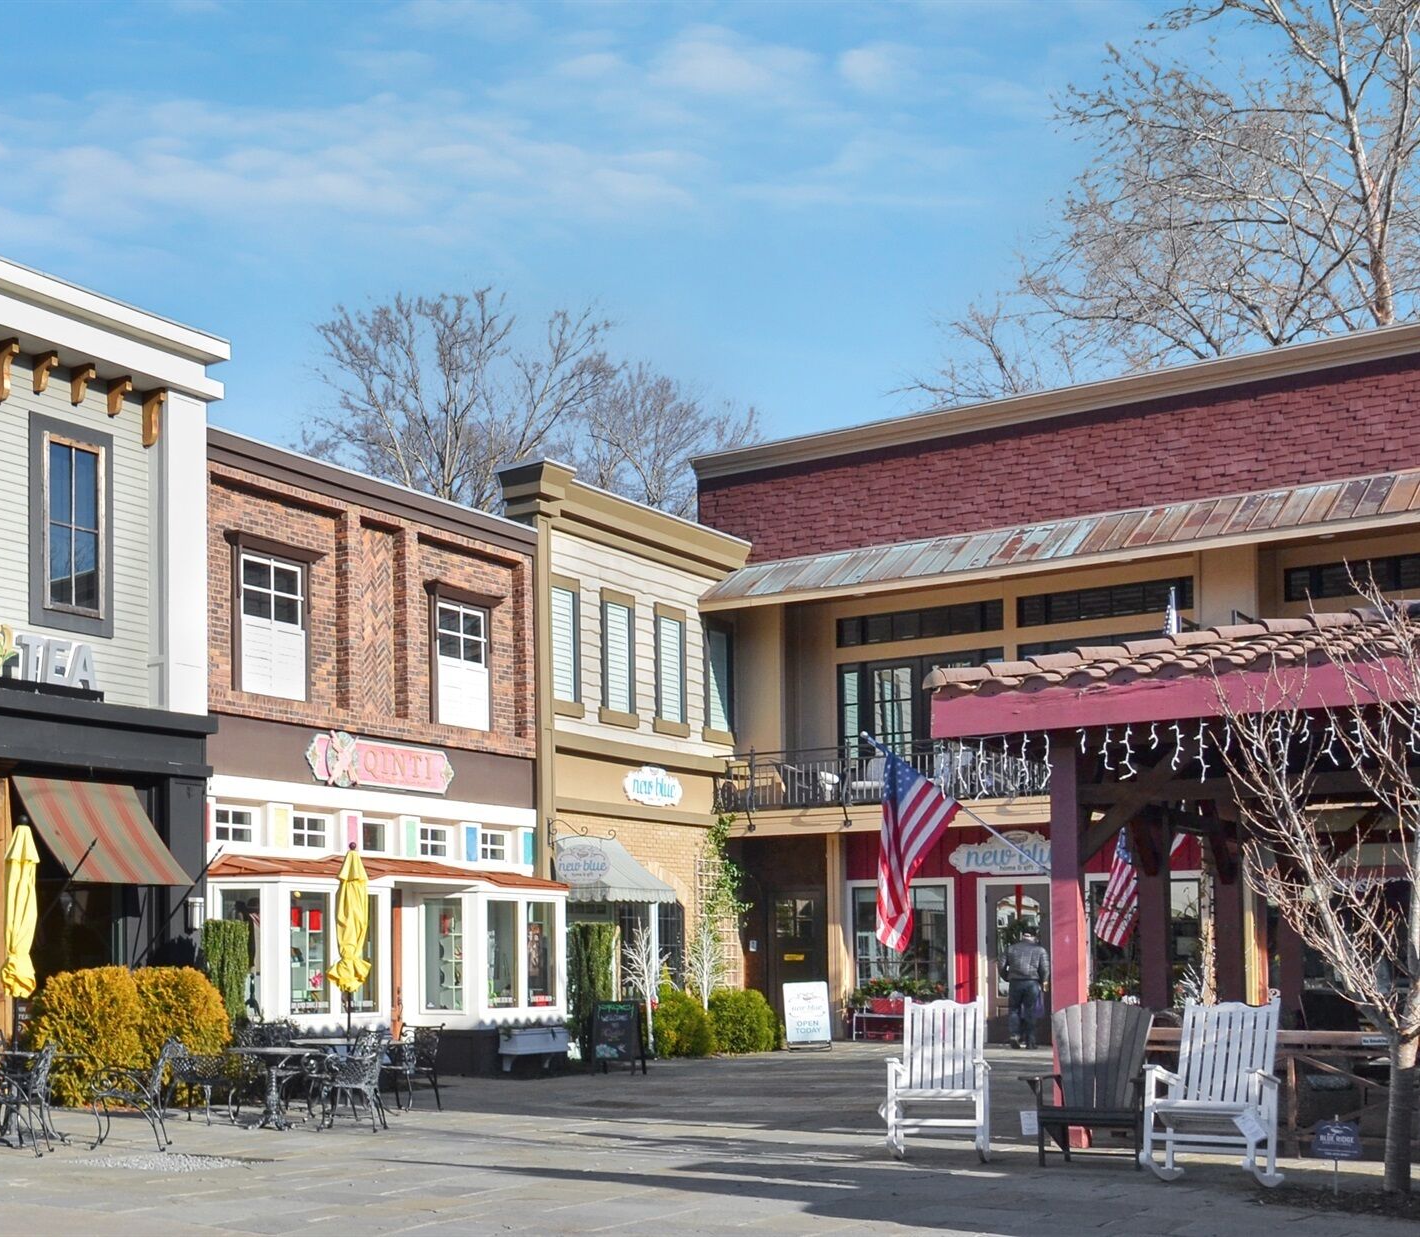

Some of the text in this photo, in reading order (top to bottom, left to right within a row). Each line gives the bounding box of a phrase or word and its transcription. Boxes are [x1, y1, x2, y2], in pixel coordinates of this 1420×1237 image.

[14, 634, 97, 690] TEA
[363, 750, 432, 779] QINTI
[655, 777, 676, 798] blue
[558, 859, 607, 872] new blue
[965, 843, 1052, 868] new blu
